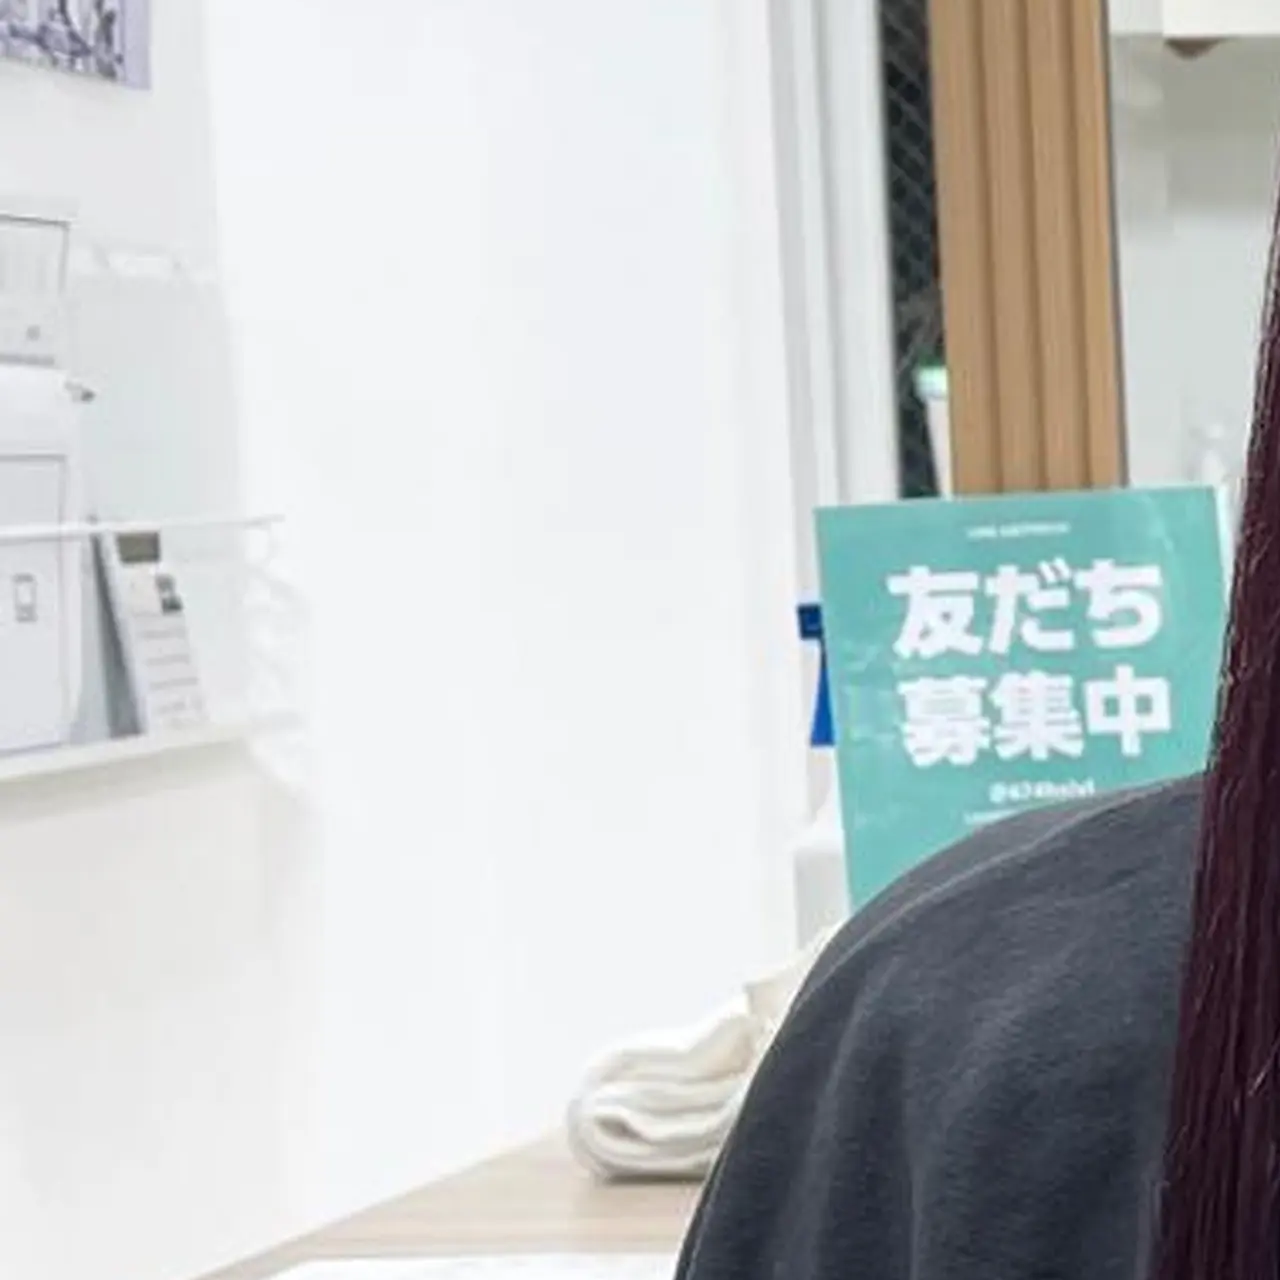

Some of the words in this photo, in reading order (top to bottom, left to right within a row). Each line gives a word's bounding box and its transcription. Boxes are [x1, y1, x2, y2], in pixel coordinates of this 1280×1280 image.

[886, 556, 1164, 659] 友だち
[897, 664, 1172, 768] 募集中
